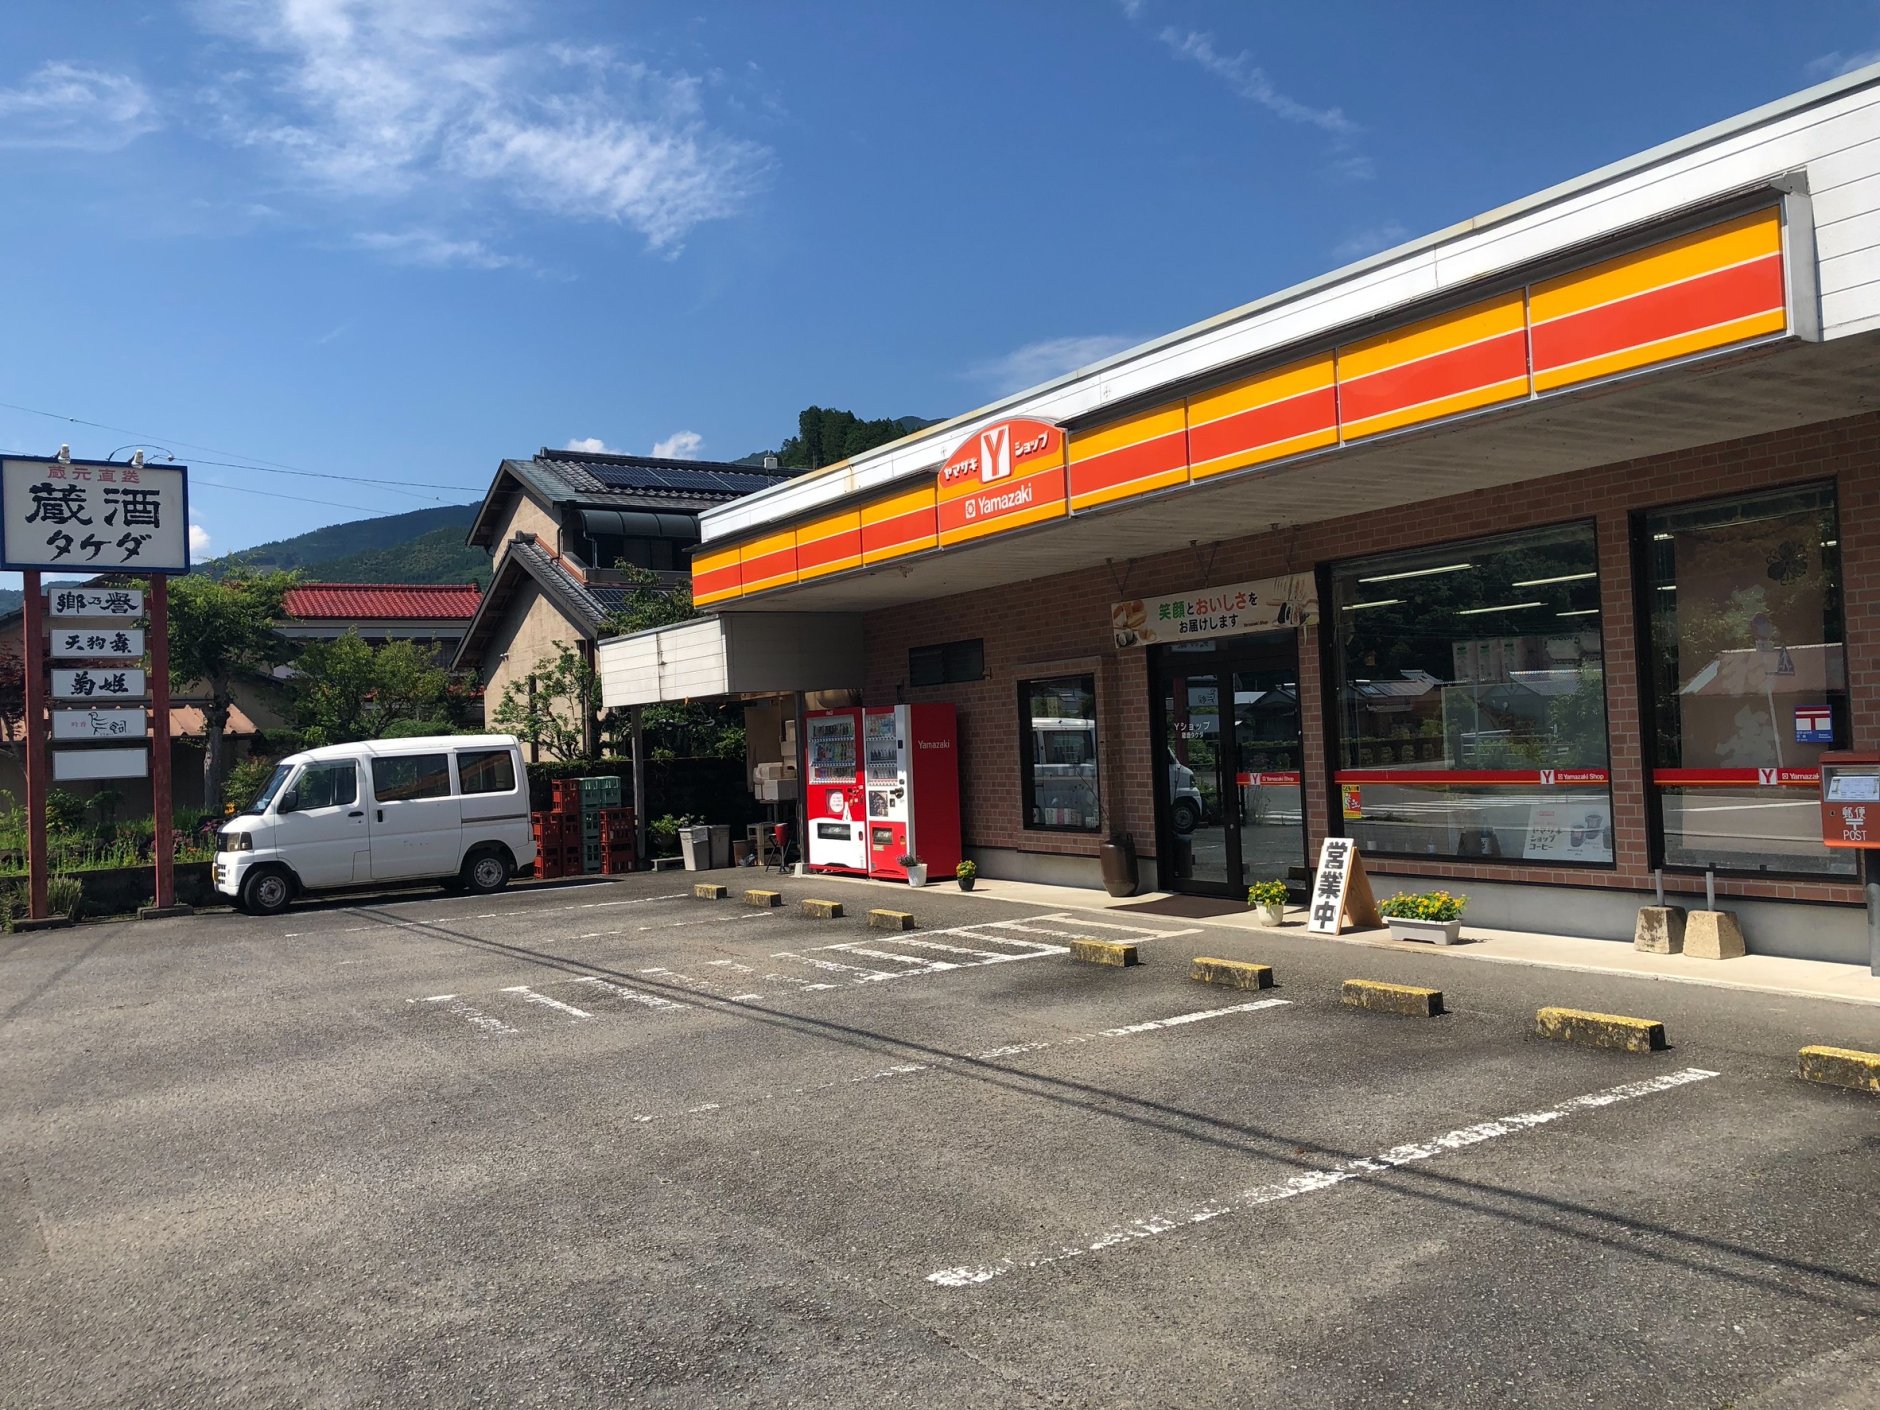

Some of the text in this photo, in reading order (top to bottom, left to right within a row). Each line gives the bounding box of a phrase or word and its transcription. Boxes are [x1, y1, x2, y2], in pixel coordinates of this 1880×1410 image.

[982, 427, 1008, 478] Y
[1014, 430, 1049, 458] ショップ
[47, 465, 140, 484] 蔵元直送
[943, 457, 979, 480] ヤマザキ
[978, 482, 1033, 515] Yamazaki
[46, 529, 153, 563] タケダ
[1158, 591, 1258, 621] 笑顔とおいしさを
[1179, 613, 1239, 634] お届けします
[1173, 721, 1211, 732] Yショップ
[917, 739, 951, 749] Yamazaki
[1541, 770, 1604, 784] Y Yamazaki Shop
[1760, 769, 1820, 784] Y Yamazak
[1842, 806, 1867, 820] 郵便
[1843, 829, 1867, 841] POST
[1528, 843, 1554, 851] コーヒー
[1313, 841, 1349, 929] 営業中
